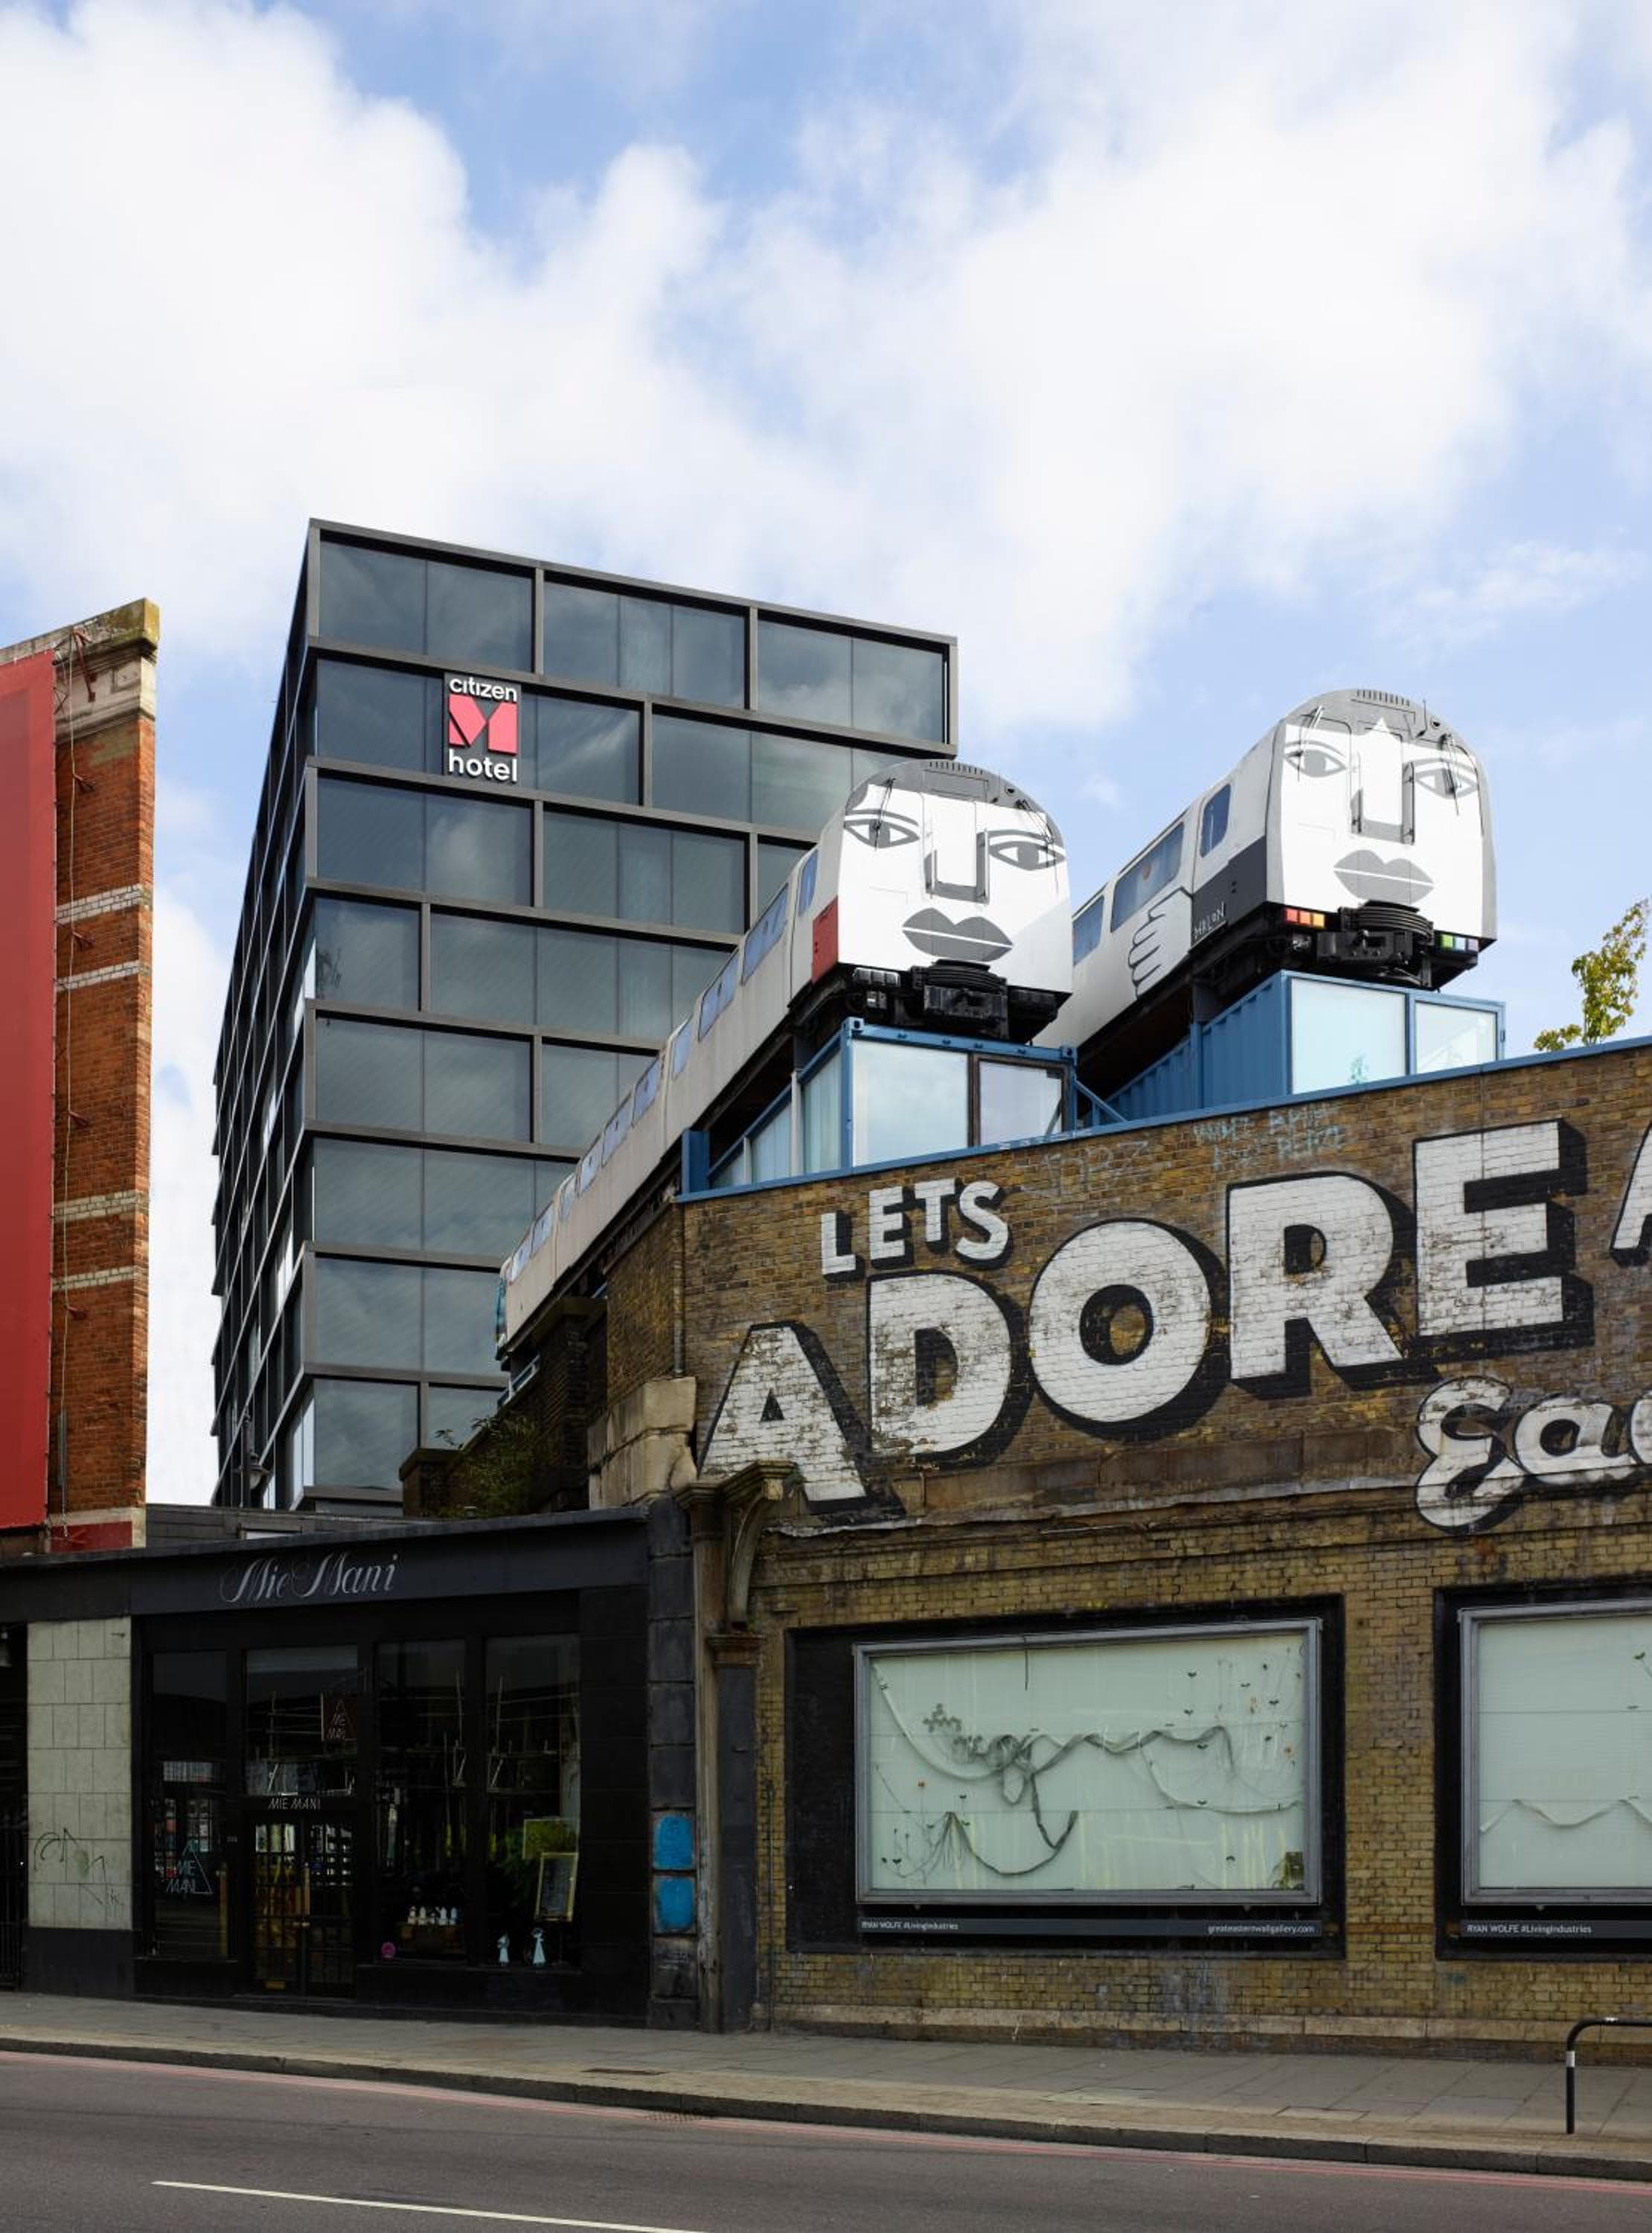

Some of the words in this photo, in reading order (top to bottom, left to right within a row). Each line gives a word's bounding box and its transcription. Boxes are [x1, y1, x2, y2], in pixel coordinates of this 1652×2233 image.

[449, 677, 518, 702] citizen
[448, 749, 518, 782] hotel
[819, 1178, 1012, 1277] LETS
[698, 1119, 1566, 1505] ADORE
[292, 1552, 399, 1598] Mani
[268, 1798, 289, 1811] MIE
[290, 1798, 321, 1811] MANI
[1467, 1924, 1488, 1933] RYAN
[1490, 1924, 1519, 1933] WOLFE
